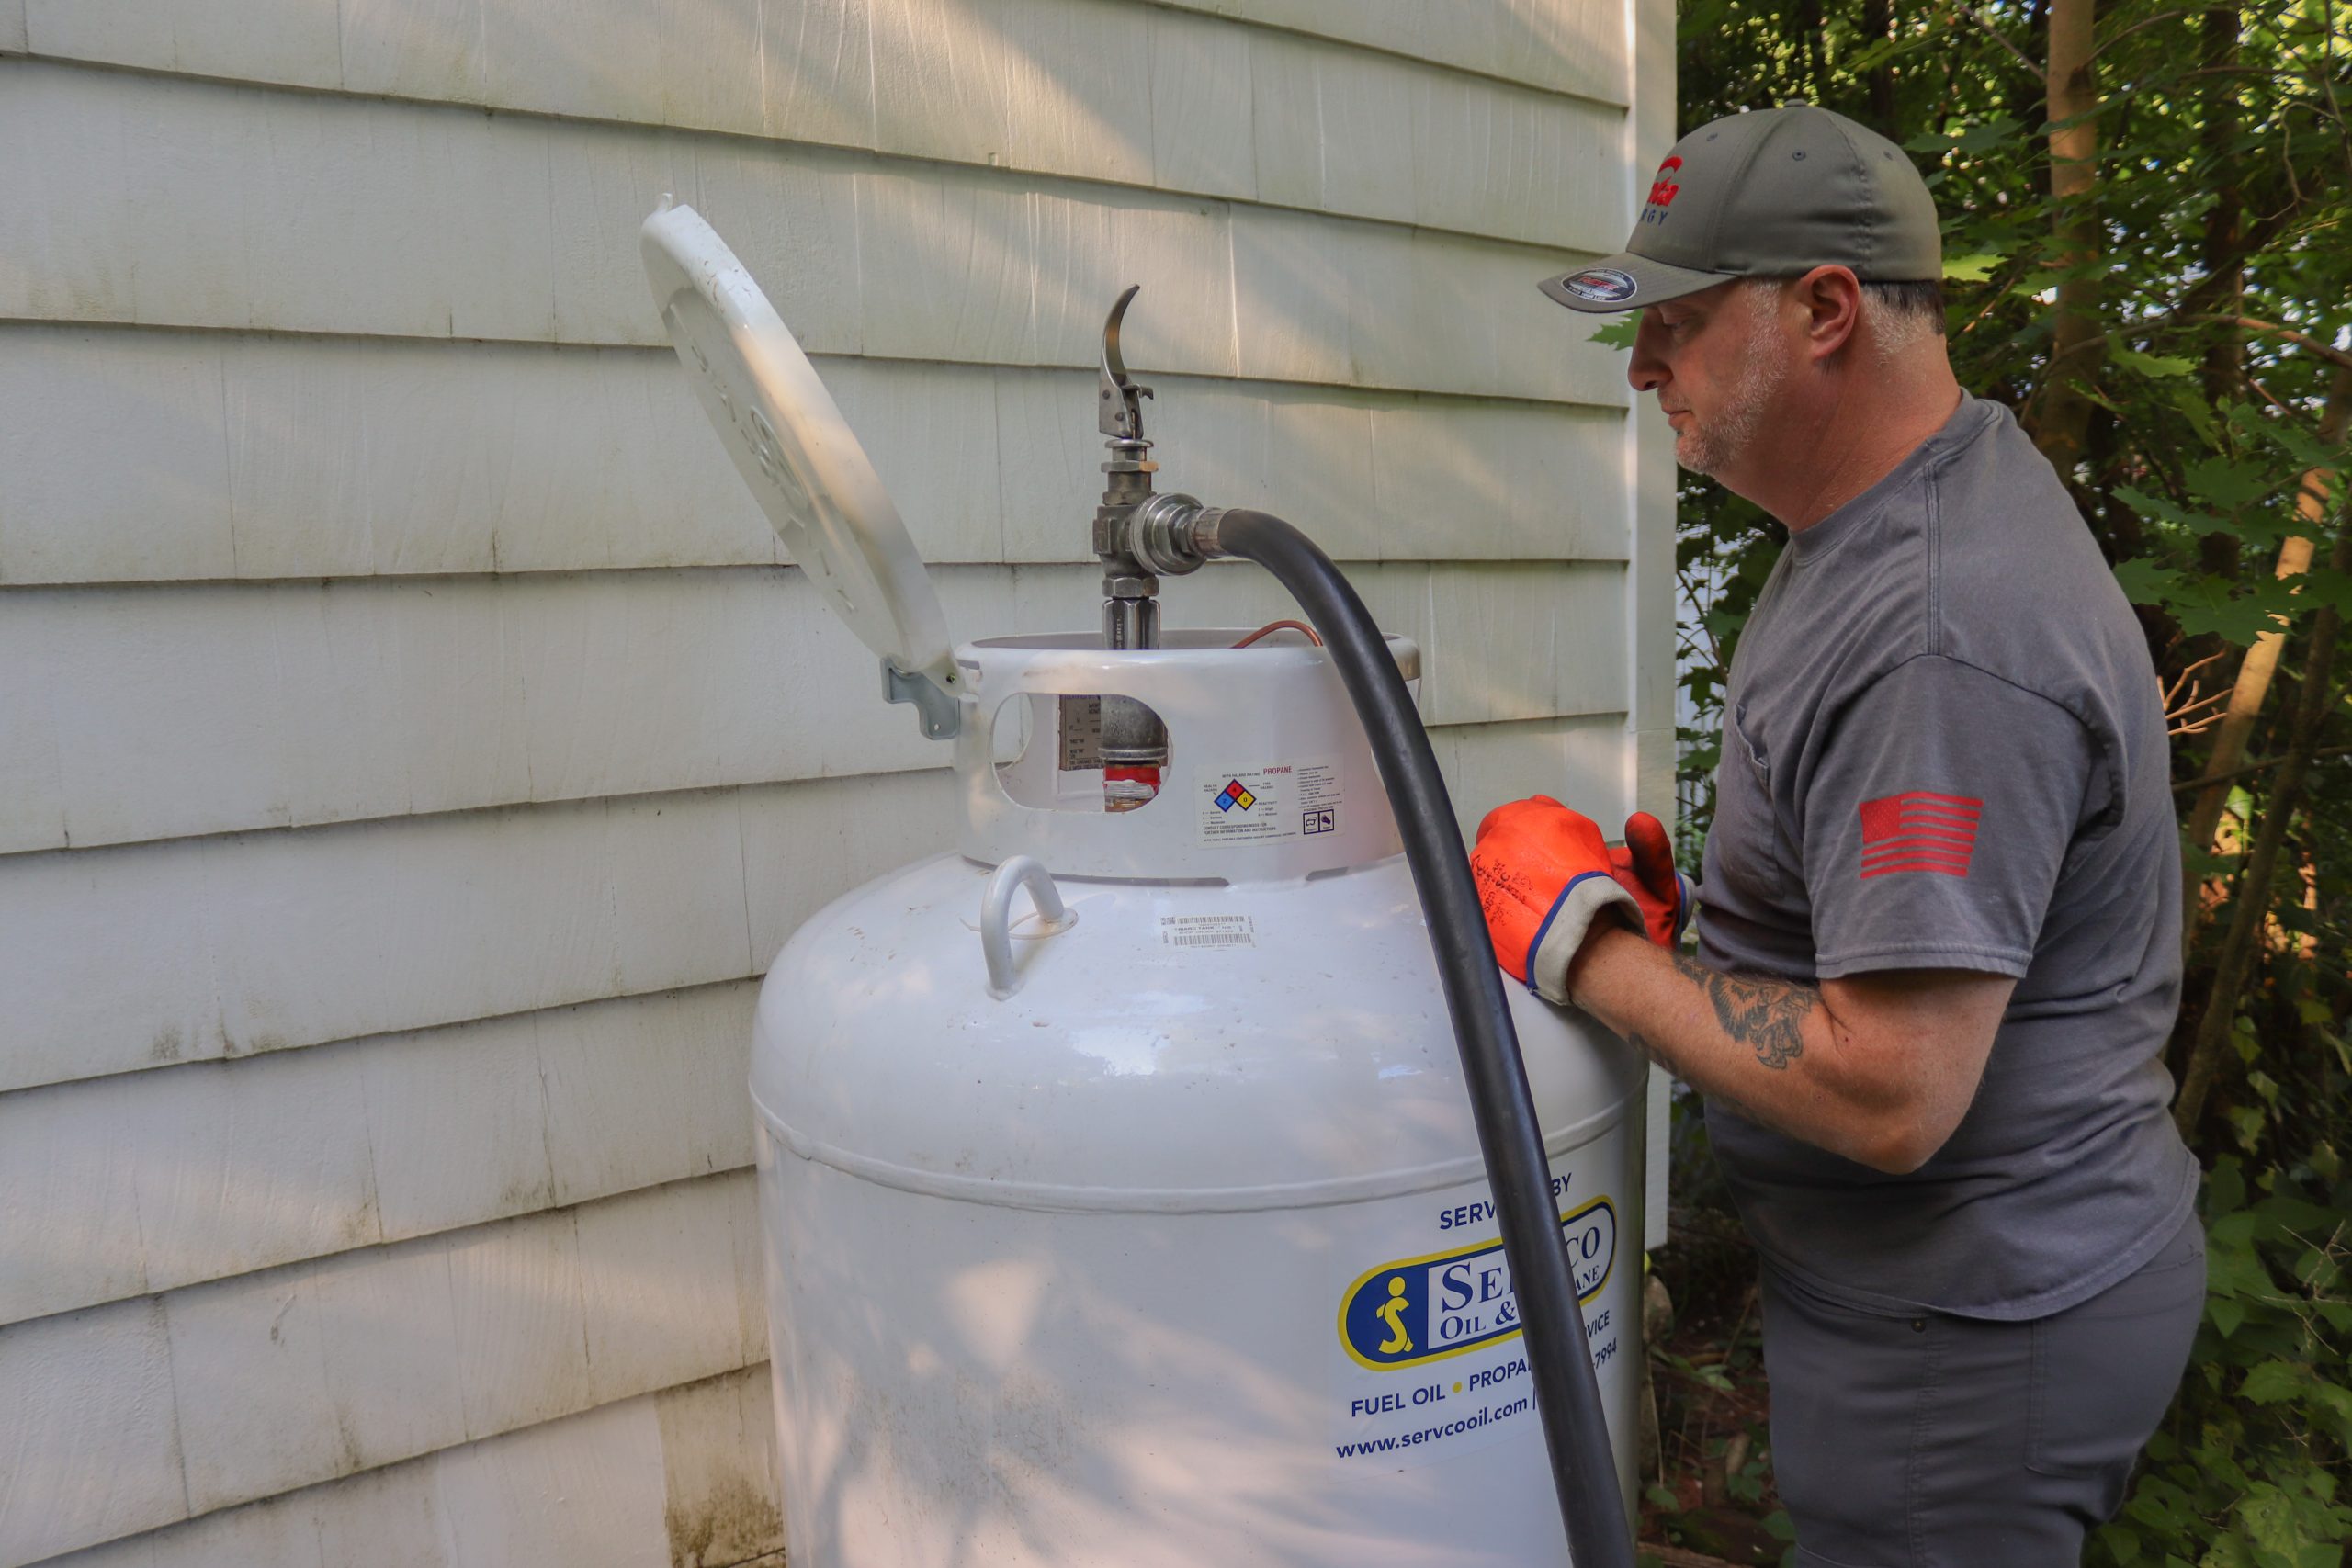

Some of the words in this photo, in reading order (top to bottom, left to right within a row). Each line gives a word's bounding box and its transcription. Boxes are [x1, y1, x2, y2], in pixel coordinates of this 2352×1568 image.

[1263, 765, 1293, 775] PROPANE
[1440, 1201, 1496, 1230] SERV
[1551, 1172, 1572, 1197] BY
[1440, 1315, 1487, 1340] OIL
[1495, 1300, 1517, 1325] &
[1351, 1393, 1406, 1417] FUEL
[1412, 1383, 1446, 1406] OIL
[1470, 1358, 1532, 1392] PROPA
[1336, 1397, 1528, 1458] www.servcooil.com
